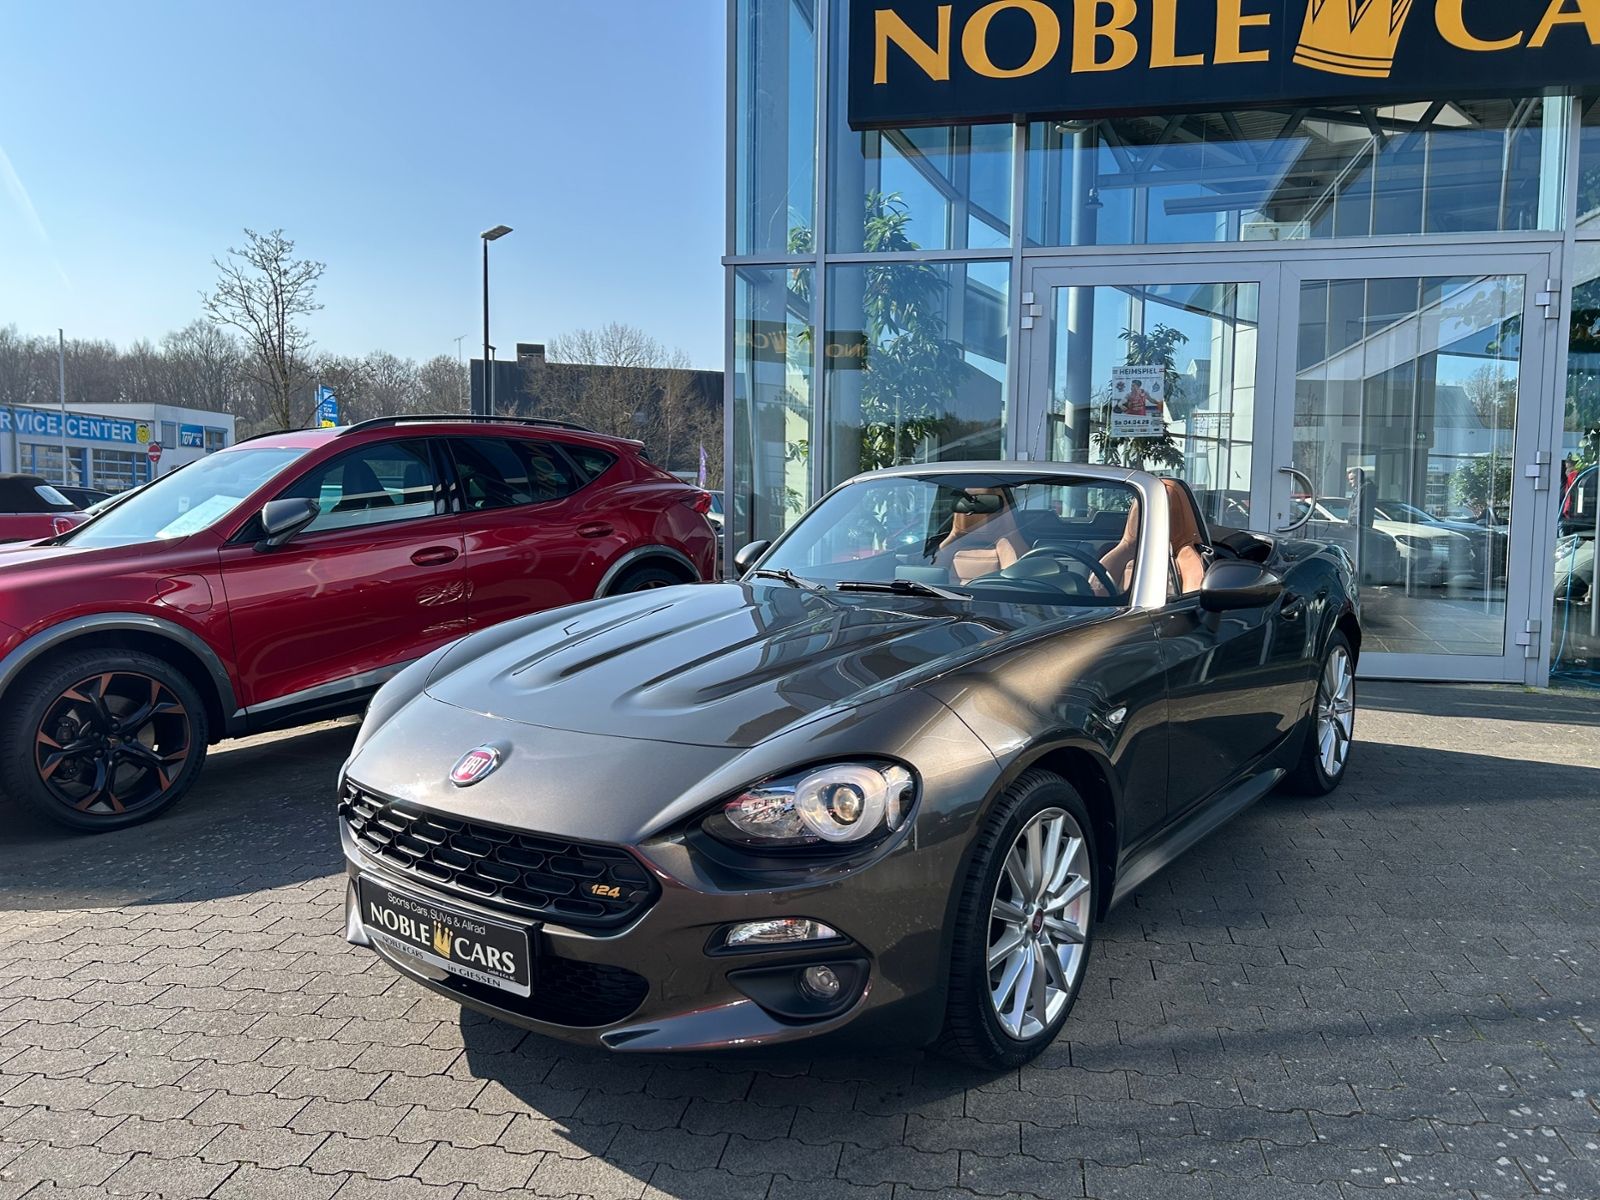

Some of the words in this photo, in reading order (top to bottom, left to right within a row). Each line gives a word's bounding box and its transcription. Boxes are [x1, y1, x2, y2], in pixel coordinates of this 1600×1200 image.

[873, 0, 1270, 85] NOBLE
[1119, 367, 1157, 376] HEIMSPIEL
[591, 884, 621, 898] 124
[387, 892, 411, 910] Sports
[411, 902, 430, 918] Cars,
[430, 909, 452, 926] SUVs
[453, 917, 460, 928] &
[461, 919, 486, 935] Allrad
[370, 901, 431, 946] NOBLE
[454, 937, 516, 974] CARS
[447, 963, 457, 973] in
[459, 968, 501, 987] GIESSEN
